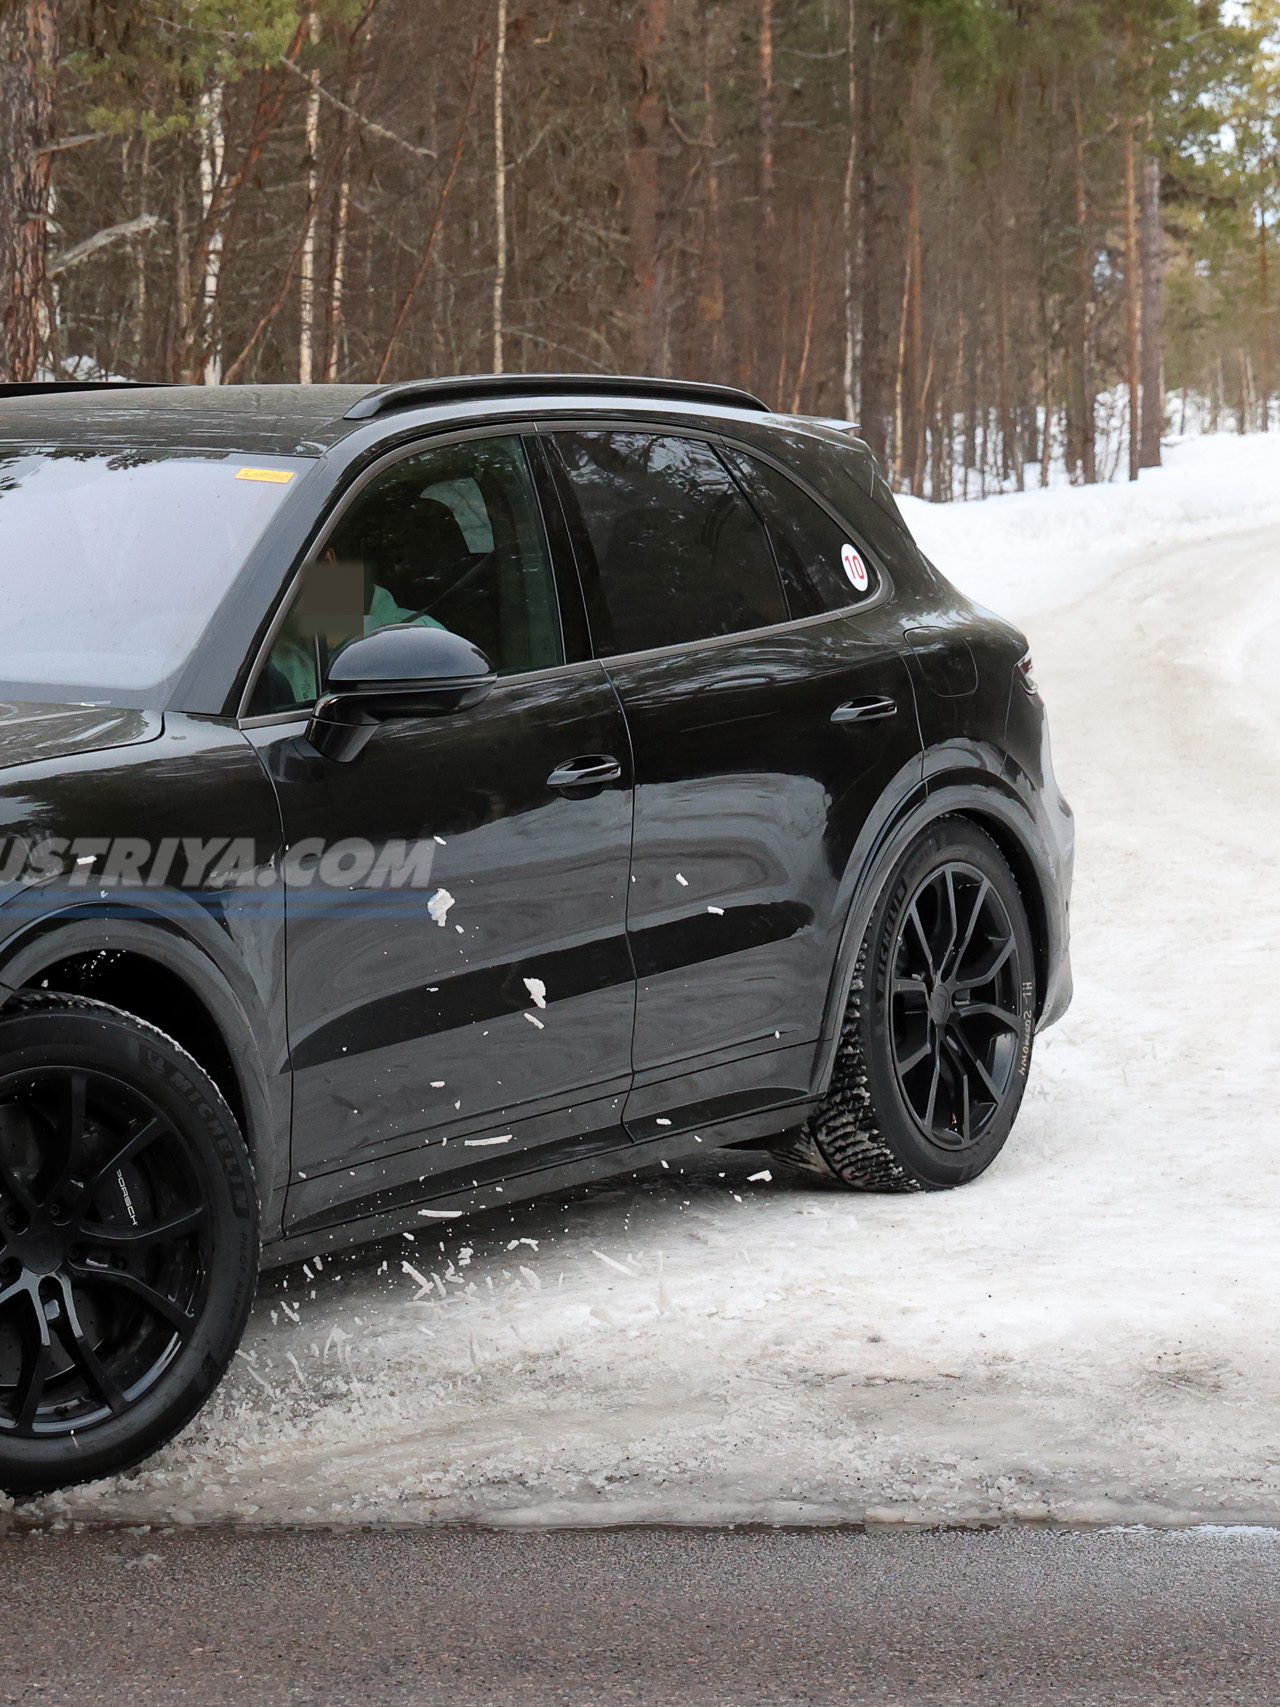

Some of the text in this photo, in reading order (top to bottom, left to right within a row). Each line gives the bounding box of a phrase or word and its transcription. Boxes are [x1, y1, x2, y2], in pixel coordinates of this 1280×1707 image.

[845, 555, 864, 580] 10
[876, 880, 908, 991] MICHELIN
[168, 1071, 249, 1210] MICHELIN
[116, 1168, 139, 1226] PORSCH
[240, 1232, 250, 1273] PILOT
